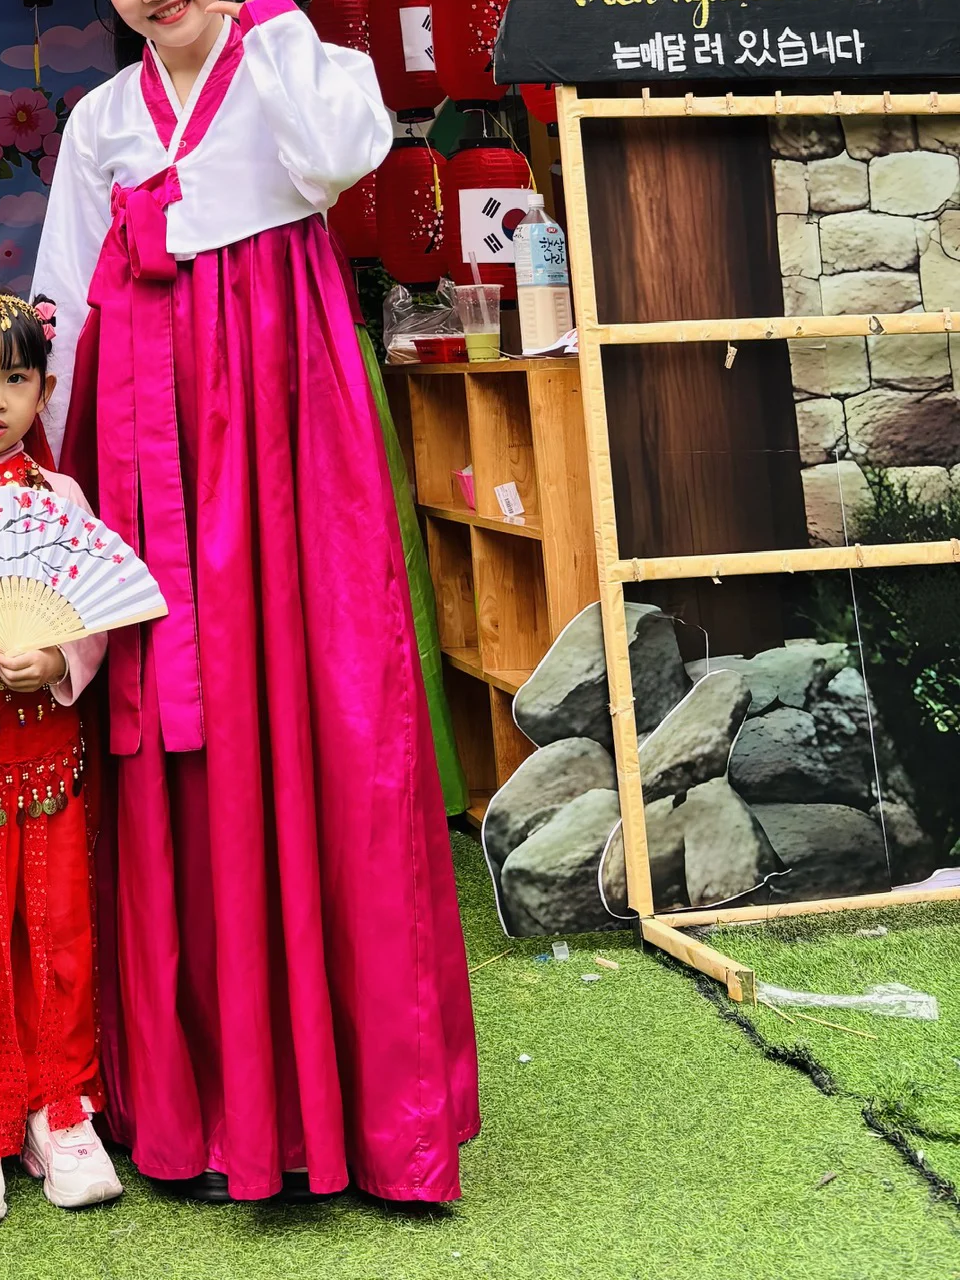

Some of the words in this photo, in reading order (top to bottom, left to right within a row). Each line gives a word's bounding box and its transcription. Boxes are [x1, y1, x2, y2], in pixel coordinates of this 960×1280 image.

[734, 26, 865, 67] 있습니다
[543, 253, 565, 264] 나라
[77, 1148, 88, 1156] 90
